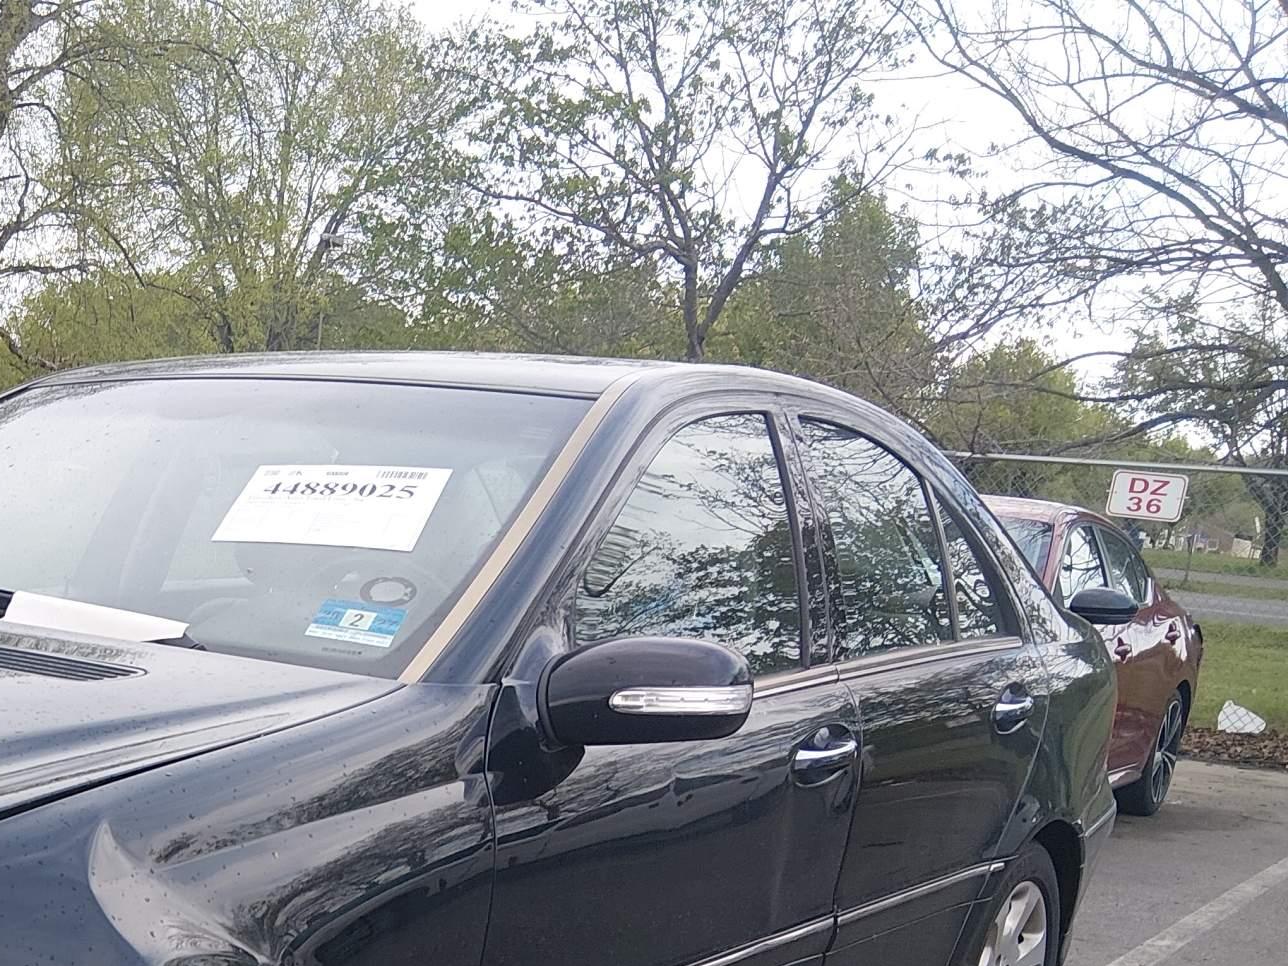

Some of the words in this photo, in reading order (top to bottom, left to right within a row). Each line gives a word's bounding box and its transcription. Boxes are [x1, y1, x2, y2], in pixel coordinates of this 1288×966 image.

[263, 481, 418, 499] 44889025
[1128, 477, 1171, 496] DZ
[1126, 496, 1162, 514] 36
[350, 613, 364, 628] 2
